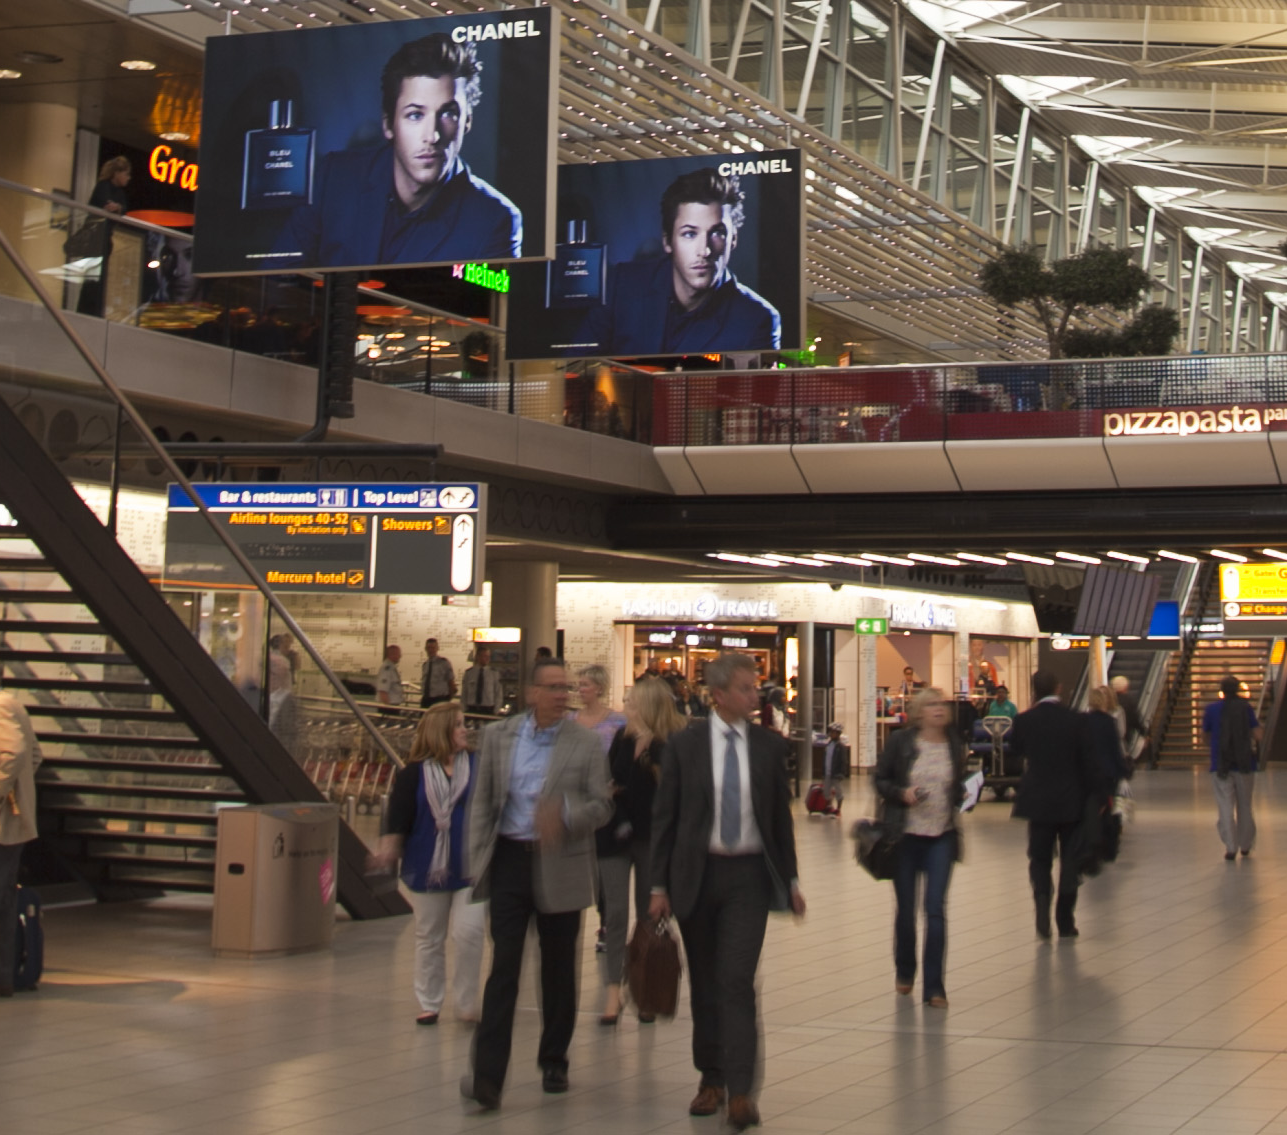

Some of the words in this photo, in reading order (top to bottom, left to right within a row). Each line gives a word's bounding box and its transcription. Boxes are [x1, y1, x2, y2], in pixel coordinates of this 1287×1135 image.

[451, 20, 541, 43] CHANEL
[149, 145, 199, 191] Gra
[265, 161, 294, 170] CHANEL
[718, 159, 793, 177] CHANEL
[1104, 405, 1262, 437] pizzapasta
[219, 490, 240, 503] Bar
[241, 490, 252, 503] &
[252, 492, 317, 504] restaurants
[363, 491, 387, 506] Top
[388, 491, 419, 504] Level
[229, 512, 267, 524] Airline
[269, 512, 313, 526] lounges
[382, 517, 433, 531] Showers
[266, 571, 313, 583] Mercure
[315, 571, 346, 583] hotel
[622, 599, 692, 616] FASHION
[718, 600, 778, 617] TRAVEL
[1255, 605, 1287, 615] Change
